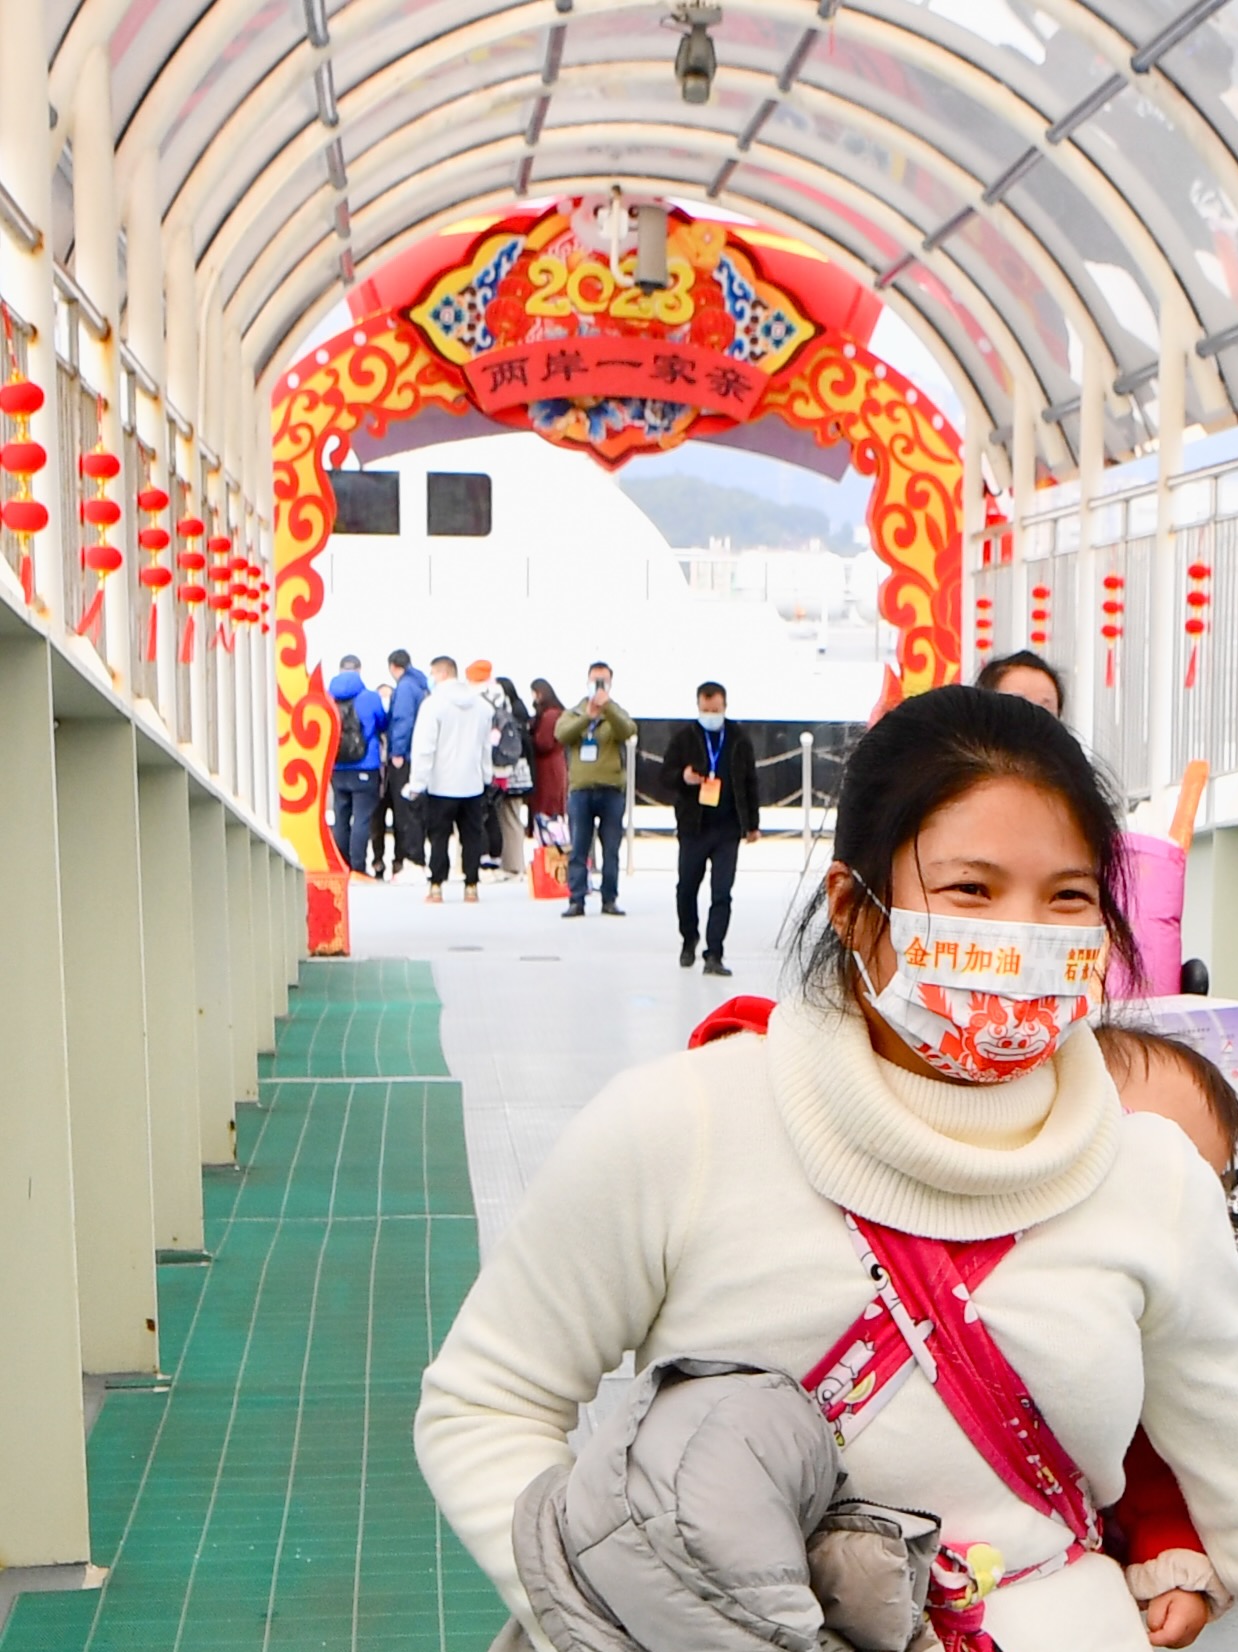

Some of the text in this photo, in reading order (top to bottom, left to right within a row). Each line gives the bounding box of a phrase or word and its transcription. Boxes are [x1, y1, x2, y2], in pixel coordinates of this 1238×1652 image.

[525, 257, 694, 324] 2023
[481, 348, 754, 403] 两岸一家亲
[903, 936, 1021, 976] 金門加油
